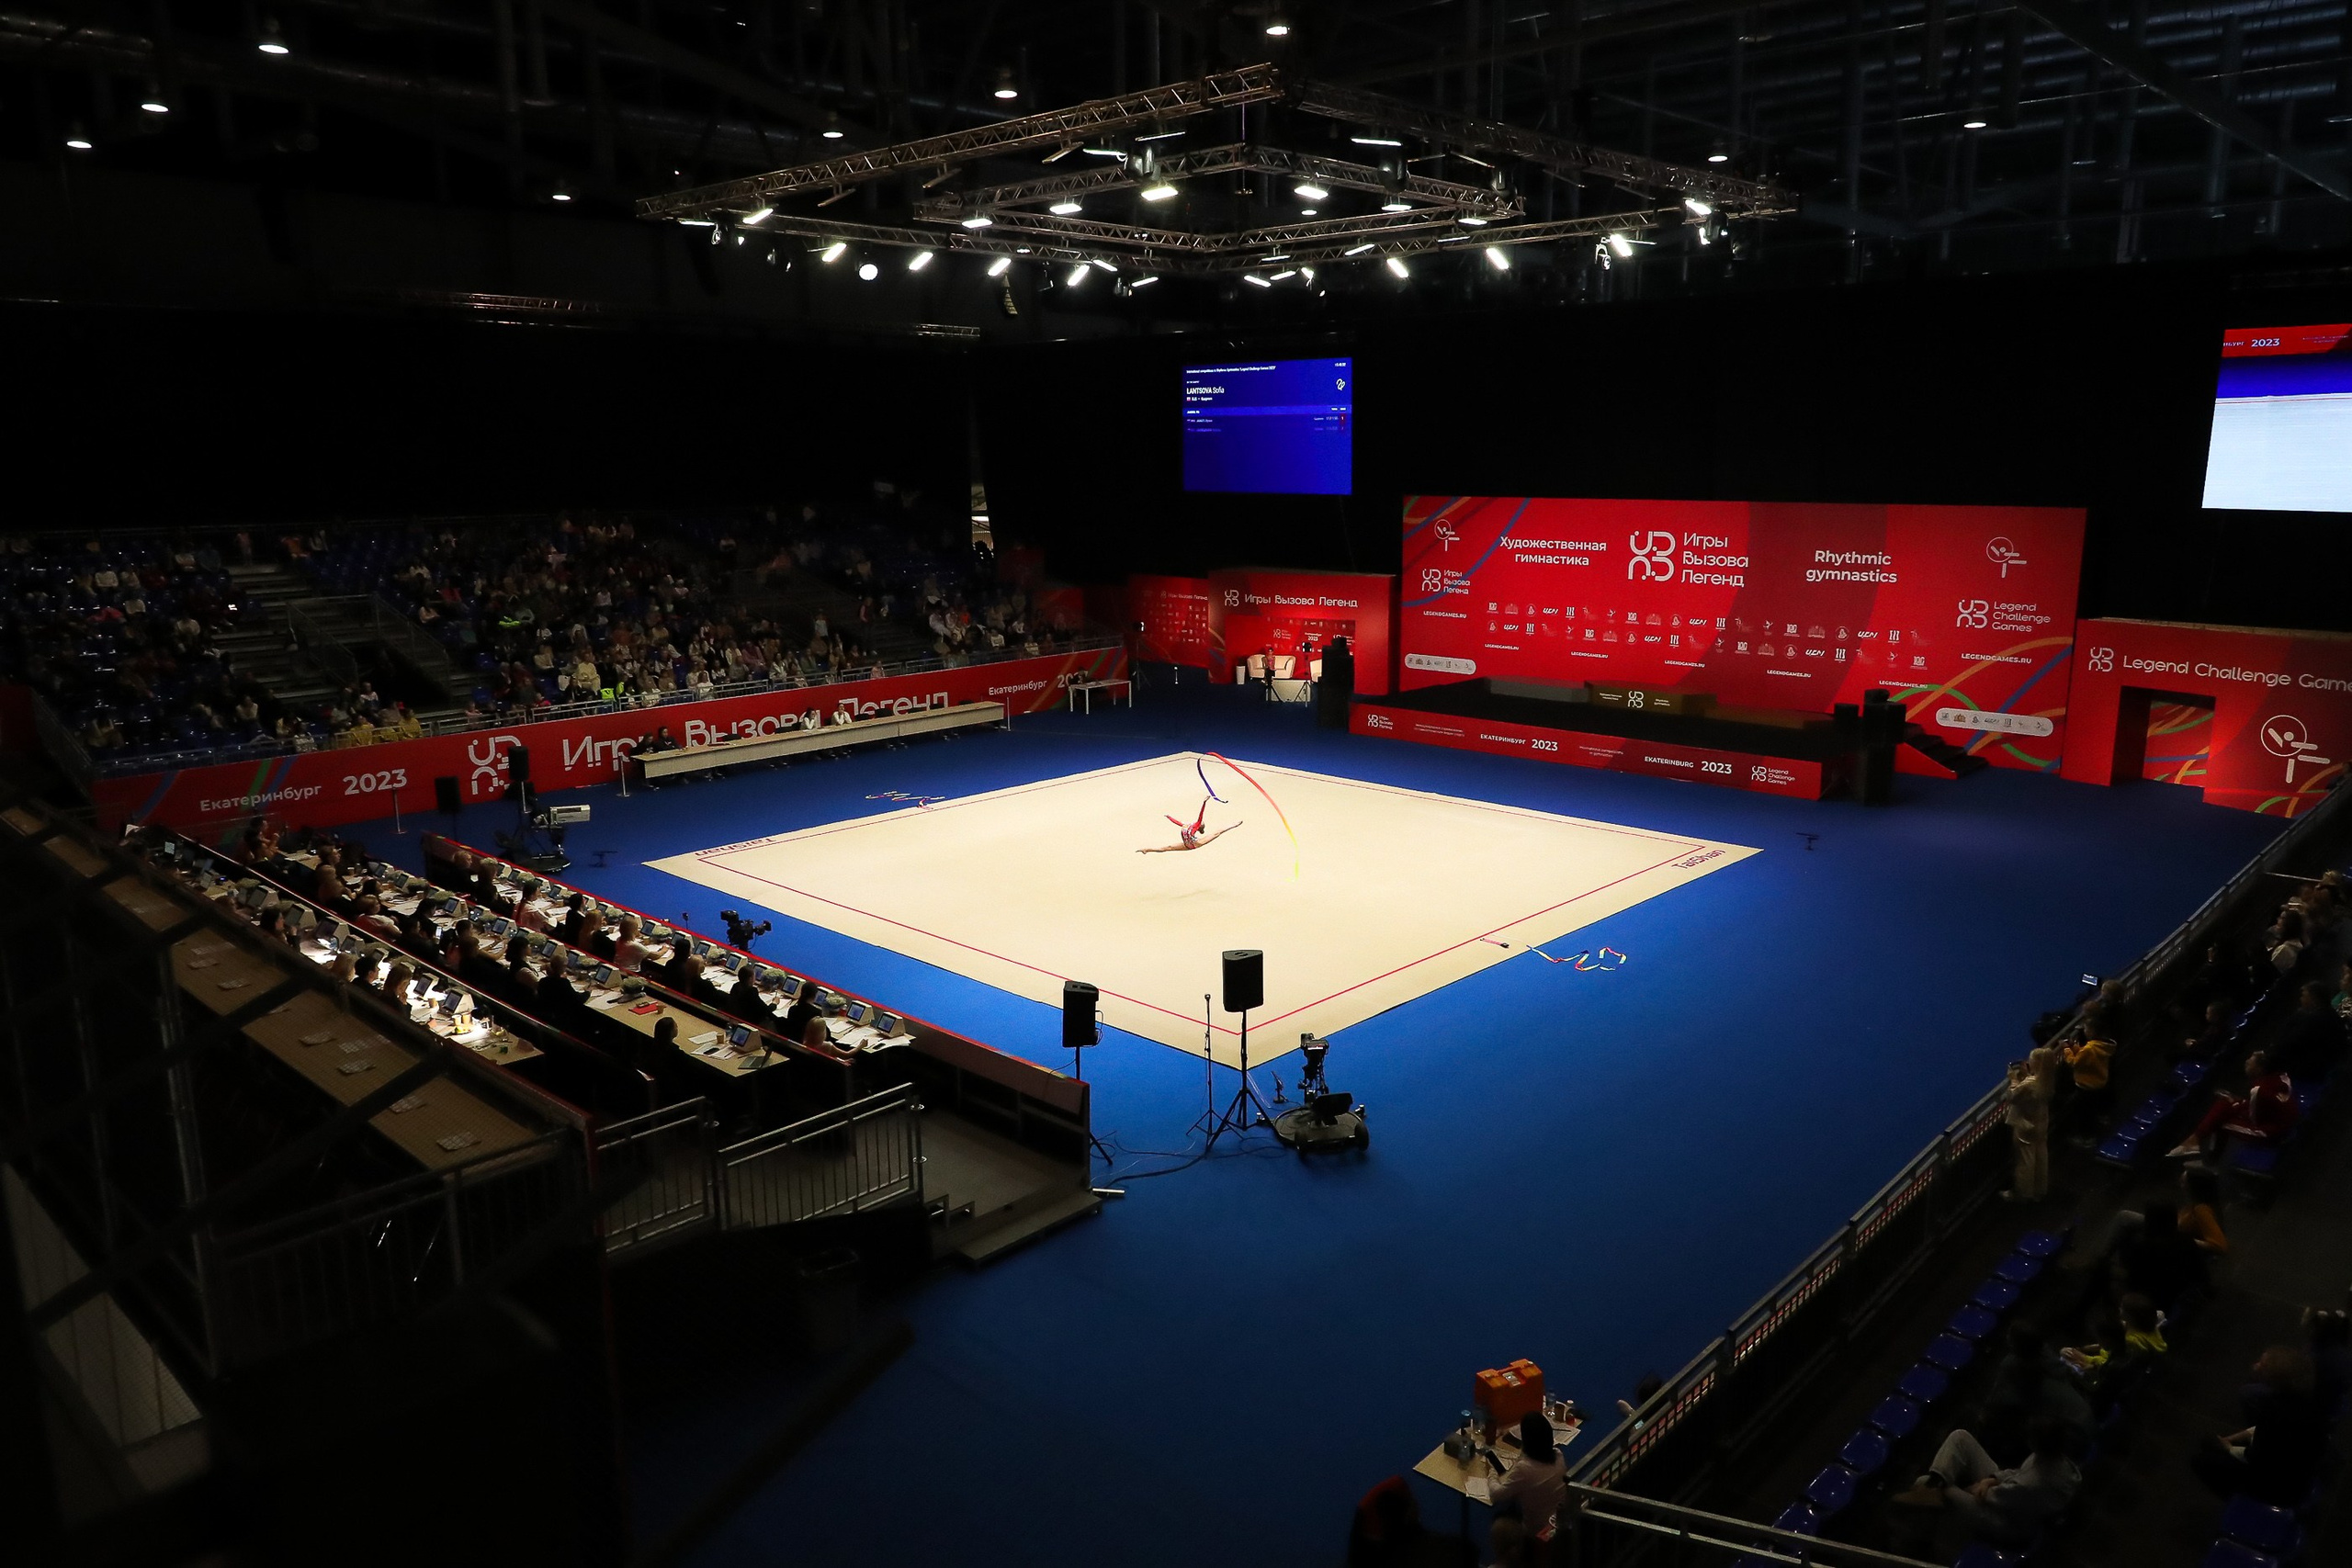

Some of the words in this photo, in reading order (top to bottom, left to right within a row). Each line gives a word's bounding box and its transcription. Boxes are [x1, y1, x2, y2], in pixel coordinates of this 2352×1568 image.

[2251, 338, 2280, 347] 2023
[1499, 536, 1607, 552] Художественная
[1683, 532, 1729, 549] Игры
[1514, 553, 1590, 566] гимнастика
[1682, 551, 1749, 569] Вызова
[1814, 549, 1893, 568] Rhythmic
[1443, 570, 1463, 578] Игры
[1680, 570, 1745, 588] Легенд
[1805, 568, 1898, 584] gymnastics
[1442, 578, 1471, 586] Вызова
[1442, 586, 1469, 595] Легенд
[1244, 593, 1271, 605] Игры
[1274, 594, 1315, 605] Вызова
[1318, 597, 1359, 608] Легенд
[1993, 601, 2037, 614] Legend
[1423, 610, 1467, 619] LEGENDGAMES.RU
[1992, 611, 2052, 625] Challenge
[1991, 621, 2033, 633] Games
[1961, 652, 2032, 664] LEGENDGAMES.RU
[1767, 669, 1812, 678] LEGENDGAMES.RU
[2122, 655, 2189, 674] Legend
[2195, 663, 2291, 687] Challenge
[988, 679, 1048, 695] Екатеринбург
[1879, 680, 1928, 689] LEGENDGAMES.RU
[1480, 733, 1526, 745] ЕКАТЕРИНБУРГ
[1531, 739, 1558, 751] 2023
[562, 735, 645, 772] Игр
[1644, 755, 1694, 769] EKATERINBURG
[1701, 761, 1733, 775] 2023
[1769, 767, 1789, 775] Legend
[1768, 773, 1795, 781] Challenge
[200, 785, 322, 811] Екатеринбург
[343, 769, 407, 795] 2023
